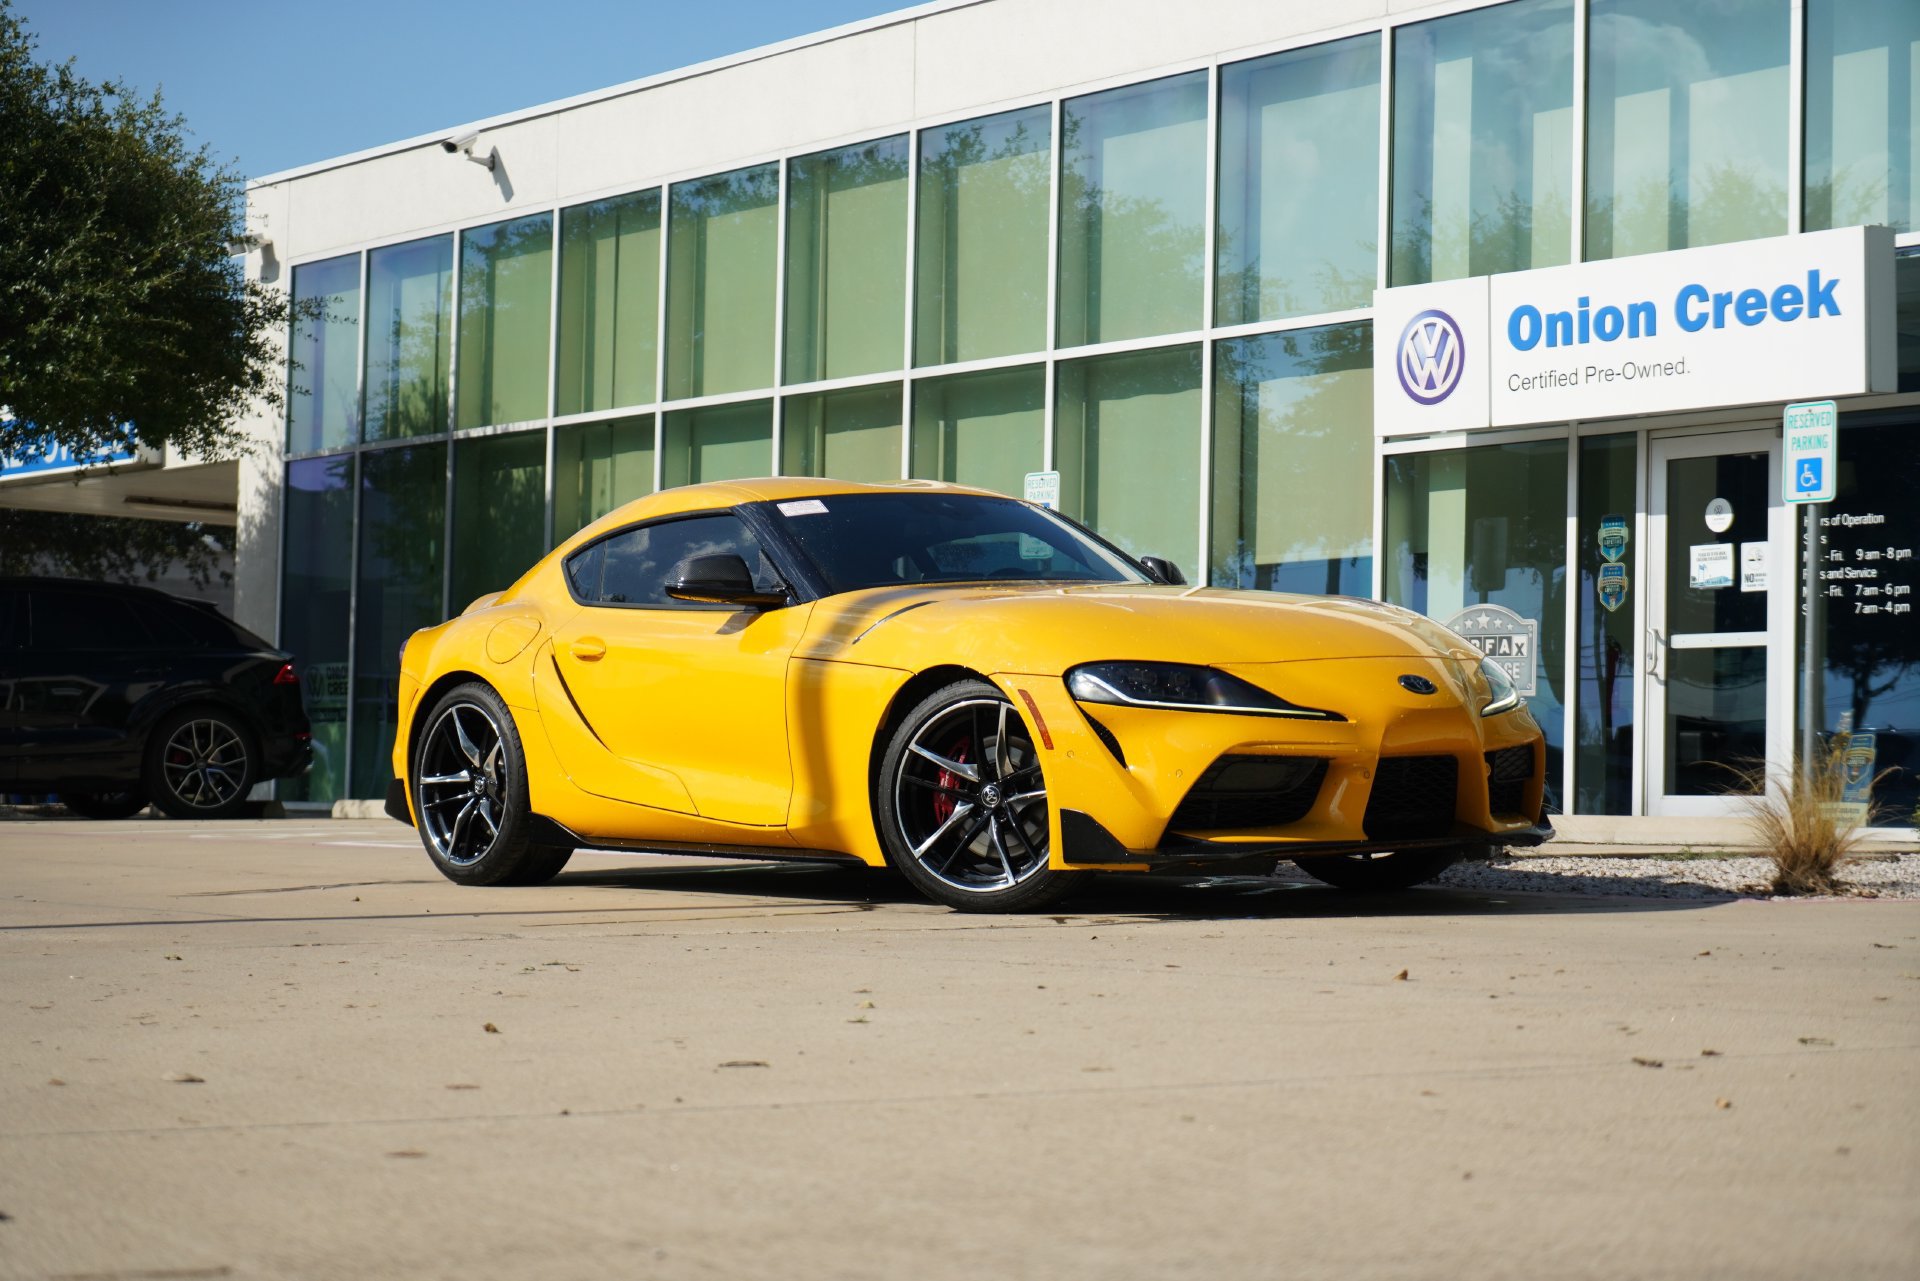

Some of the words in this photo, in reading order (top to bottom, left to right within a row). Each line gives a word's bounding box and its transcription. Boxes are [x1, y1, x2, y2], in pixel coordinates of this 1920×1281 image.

[1507, 296, 1657, 351] Onion
[1674, 269, 1842, 333] Creek
[1508, 367, 1579, 392] Certified
[1585, 356, 1691, 385] Pre-Owned.
[1788, 412, 1831, 429] RESERVED
[1792, 434, 1828, 450] PARKING
[1830, 514, 1841, 526] of
[1842, 513, 1885, 528] Operation
[1826, 568, 1844, 580] and
[1844, 566, 1878, 580] Service
